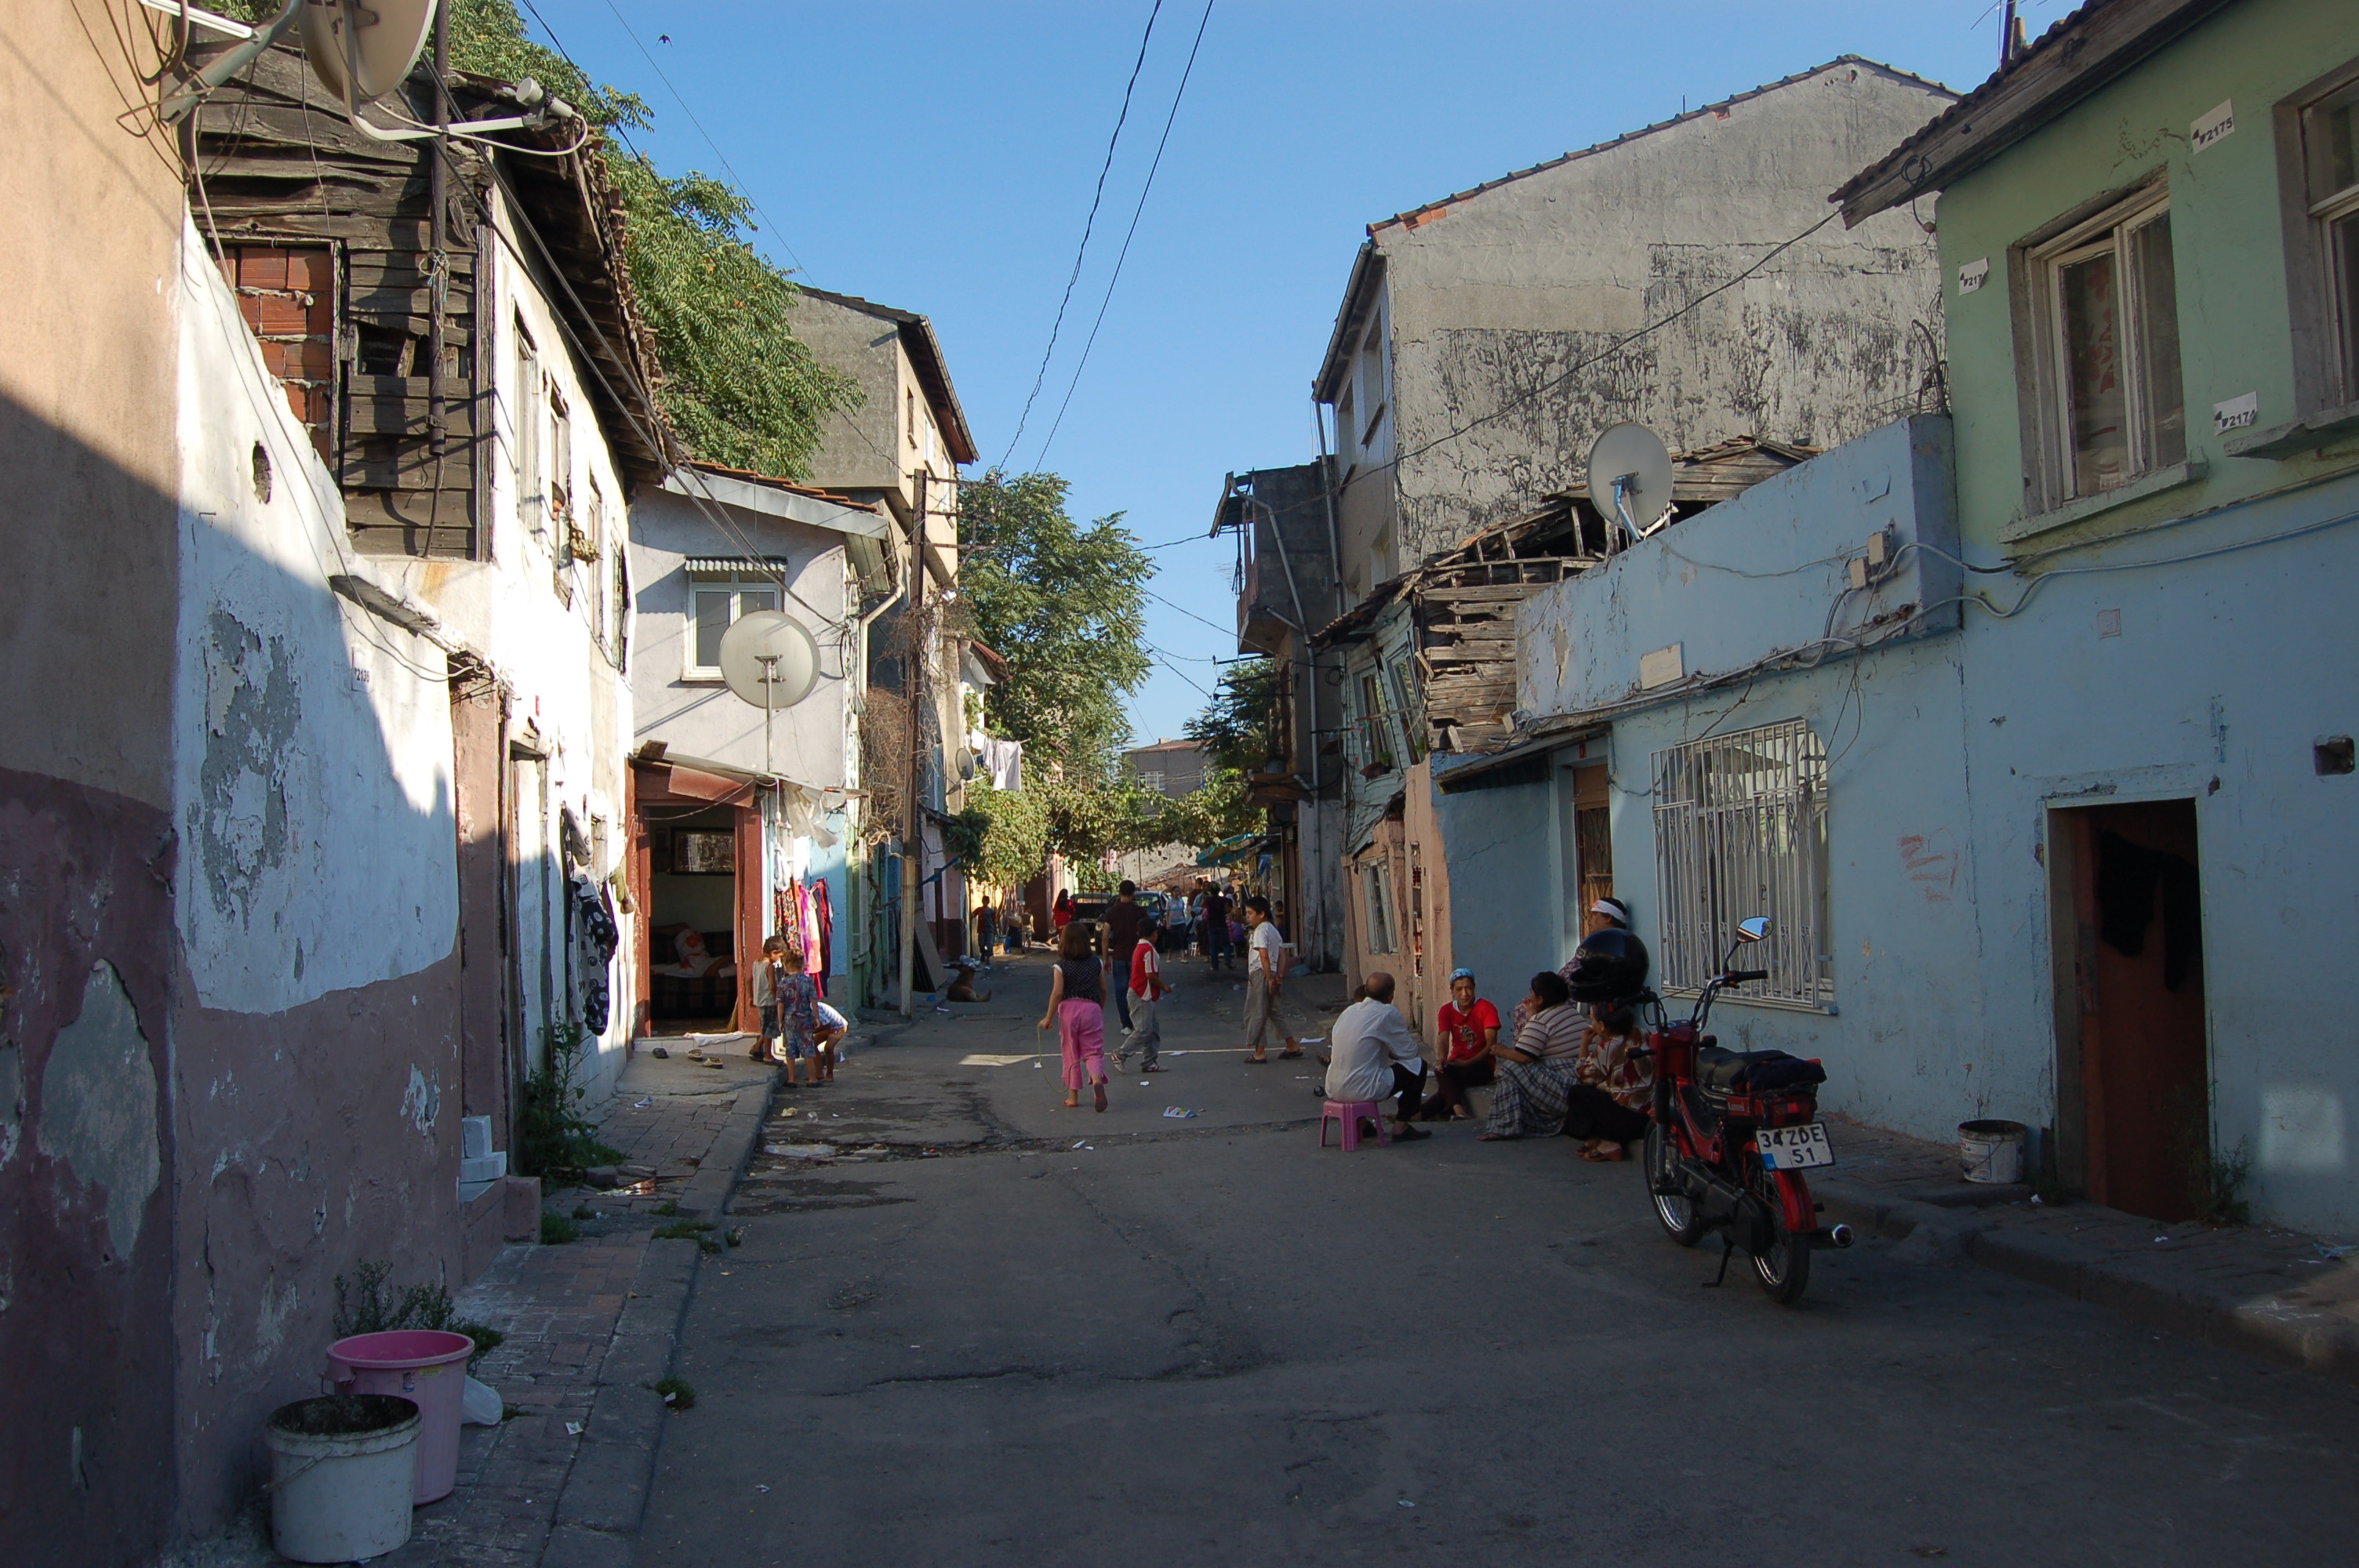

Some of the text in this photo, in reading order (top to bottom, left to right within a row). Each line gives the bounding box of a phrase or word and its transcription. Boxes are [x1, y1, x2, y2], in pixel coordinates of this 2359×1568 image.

[2206, 117, 2233, 141] 2175
[1761, 1127, 1823, 1148] 34 ZDE
[1792, 1148, 1815, 1163] 51
